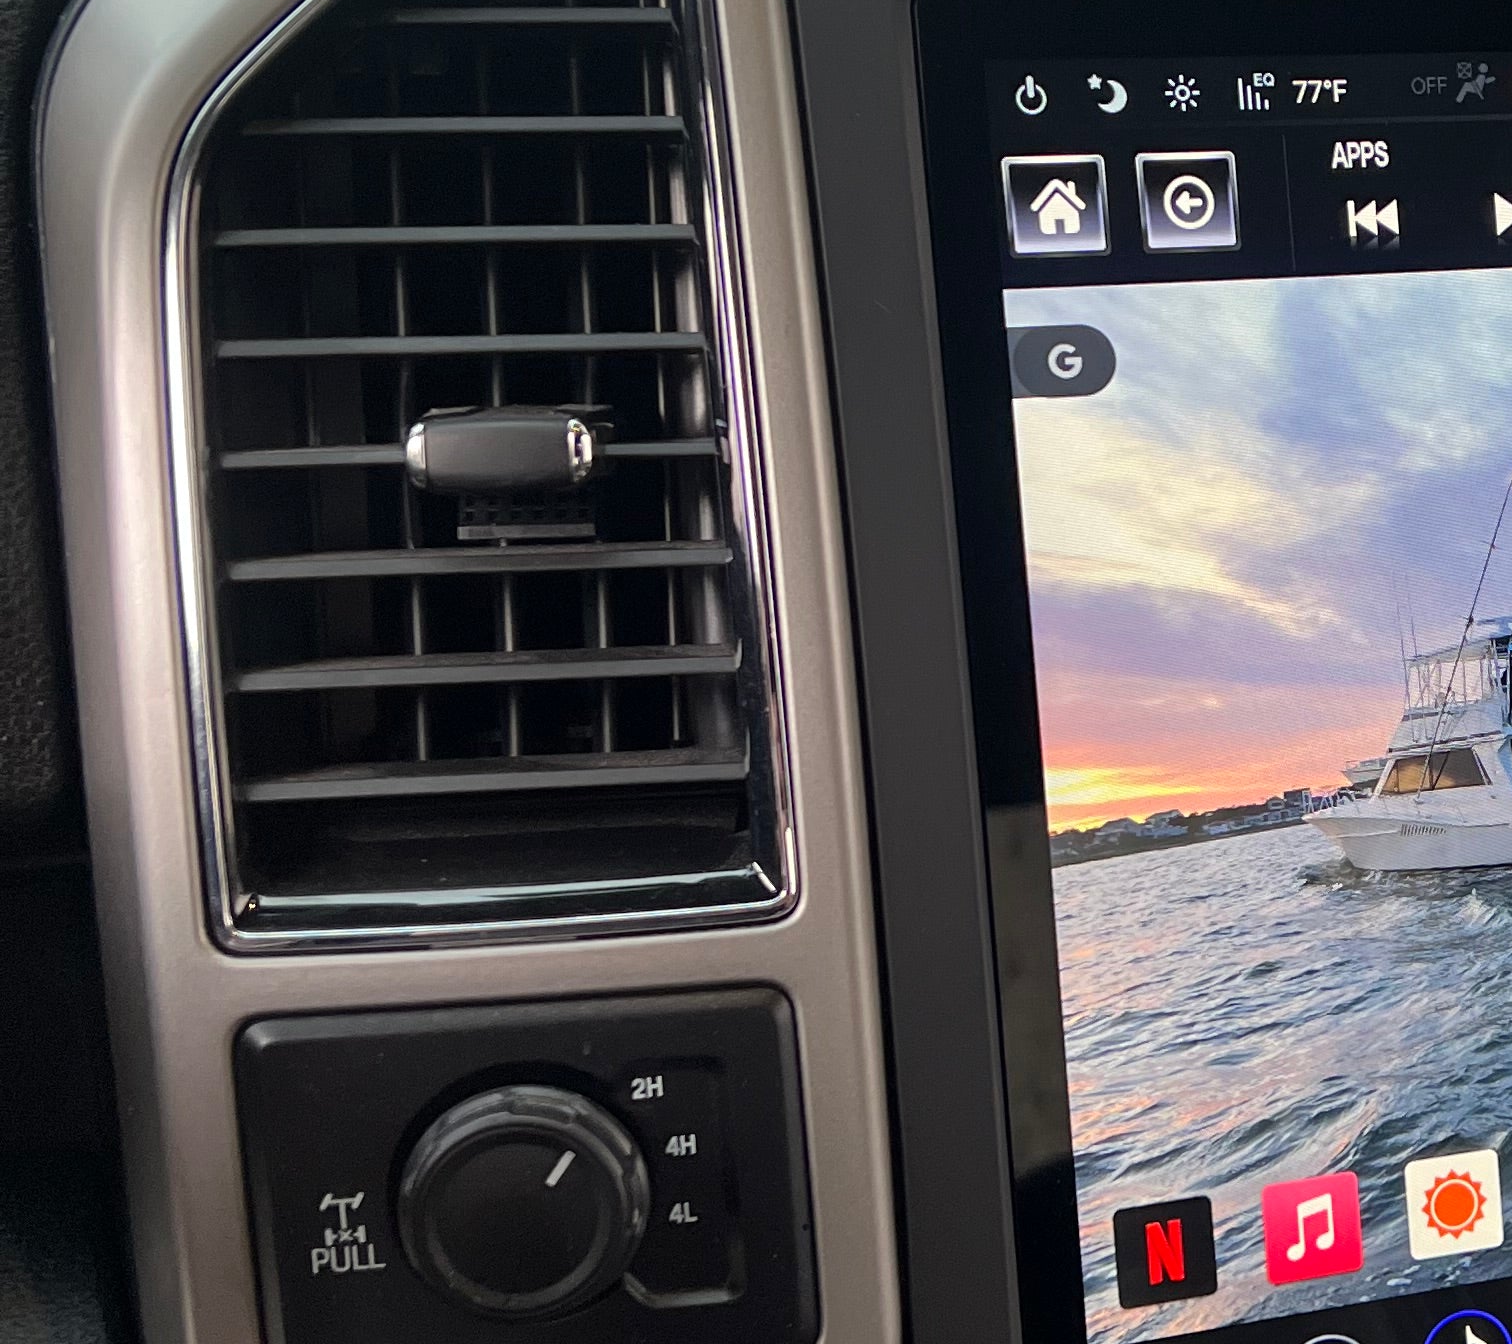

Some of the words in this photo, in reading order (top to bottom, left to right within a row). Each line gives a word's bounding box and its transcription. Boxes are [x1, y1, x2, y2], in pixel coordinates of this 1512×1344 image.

[1252, 72, 1275, 88] EQ
[1410, 75, 1447, 97] OFF
[1330, 140, 1390, 171] APPS
[1047, 343, 1083, 380] G
[630, 1075, 665, 1102] 2H
[664, 1132, 698, 1157] 4H
[668, 1201, 698, 1225] 4L
[311, 1242, 386, 1274] PULL
[1143, 1218, 1185, 1286] N
